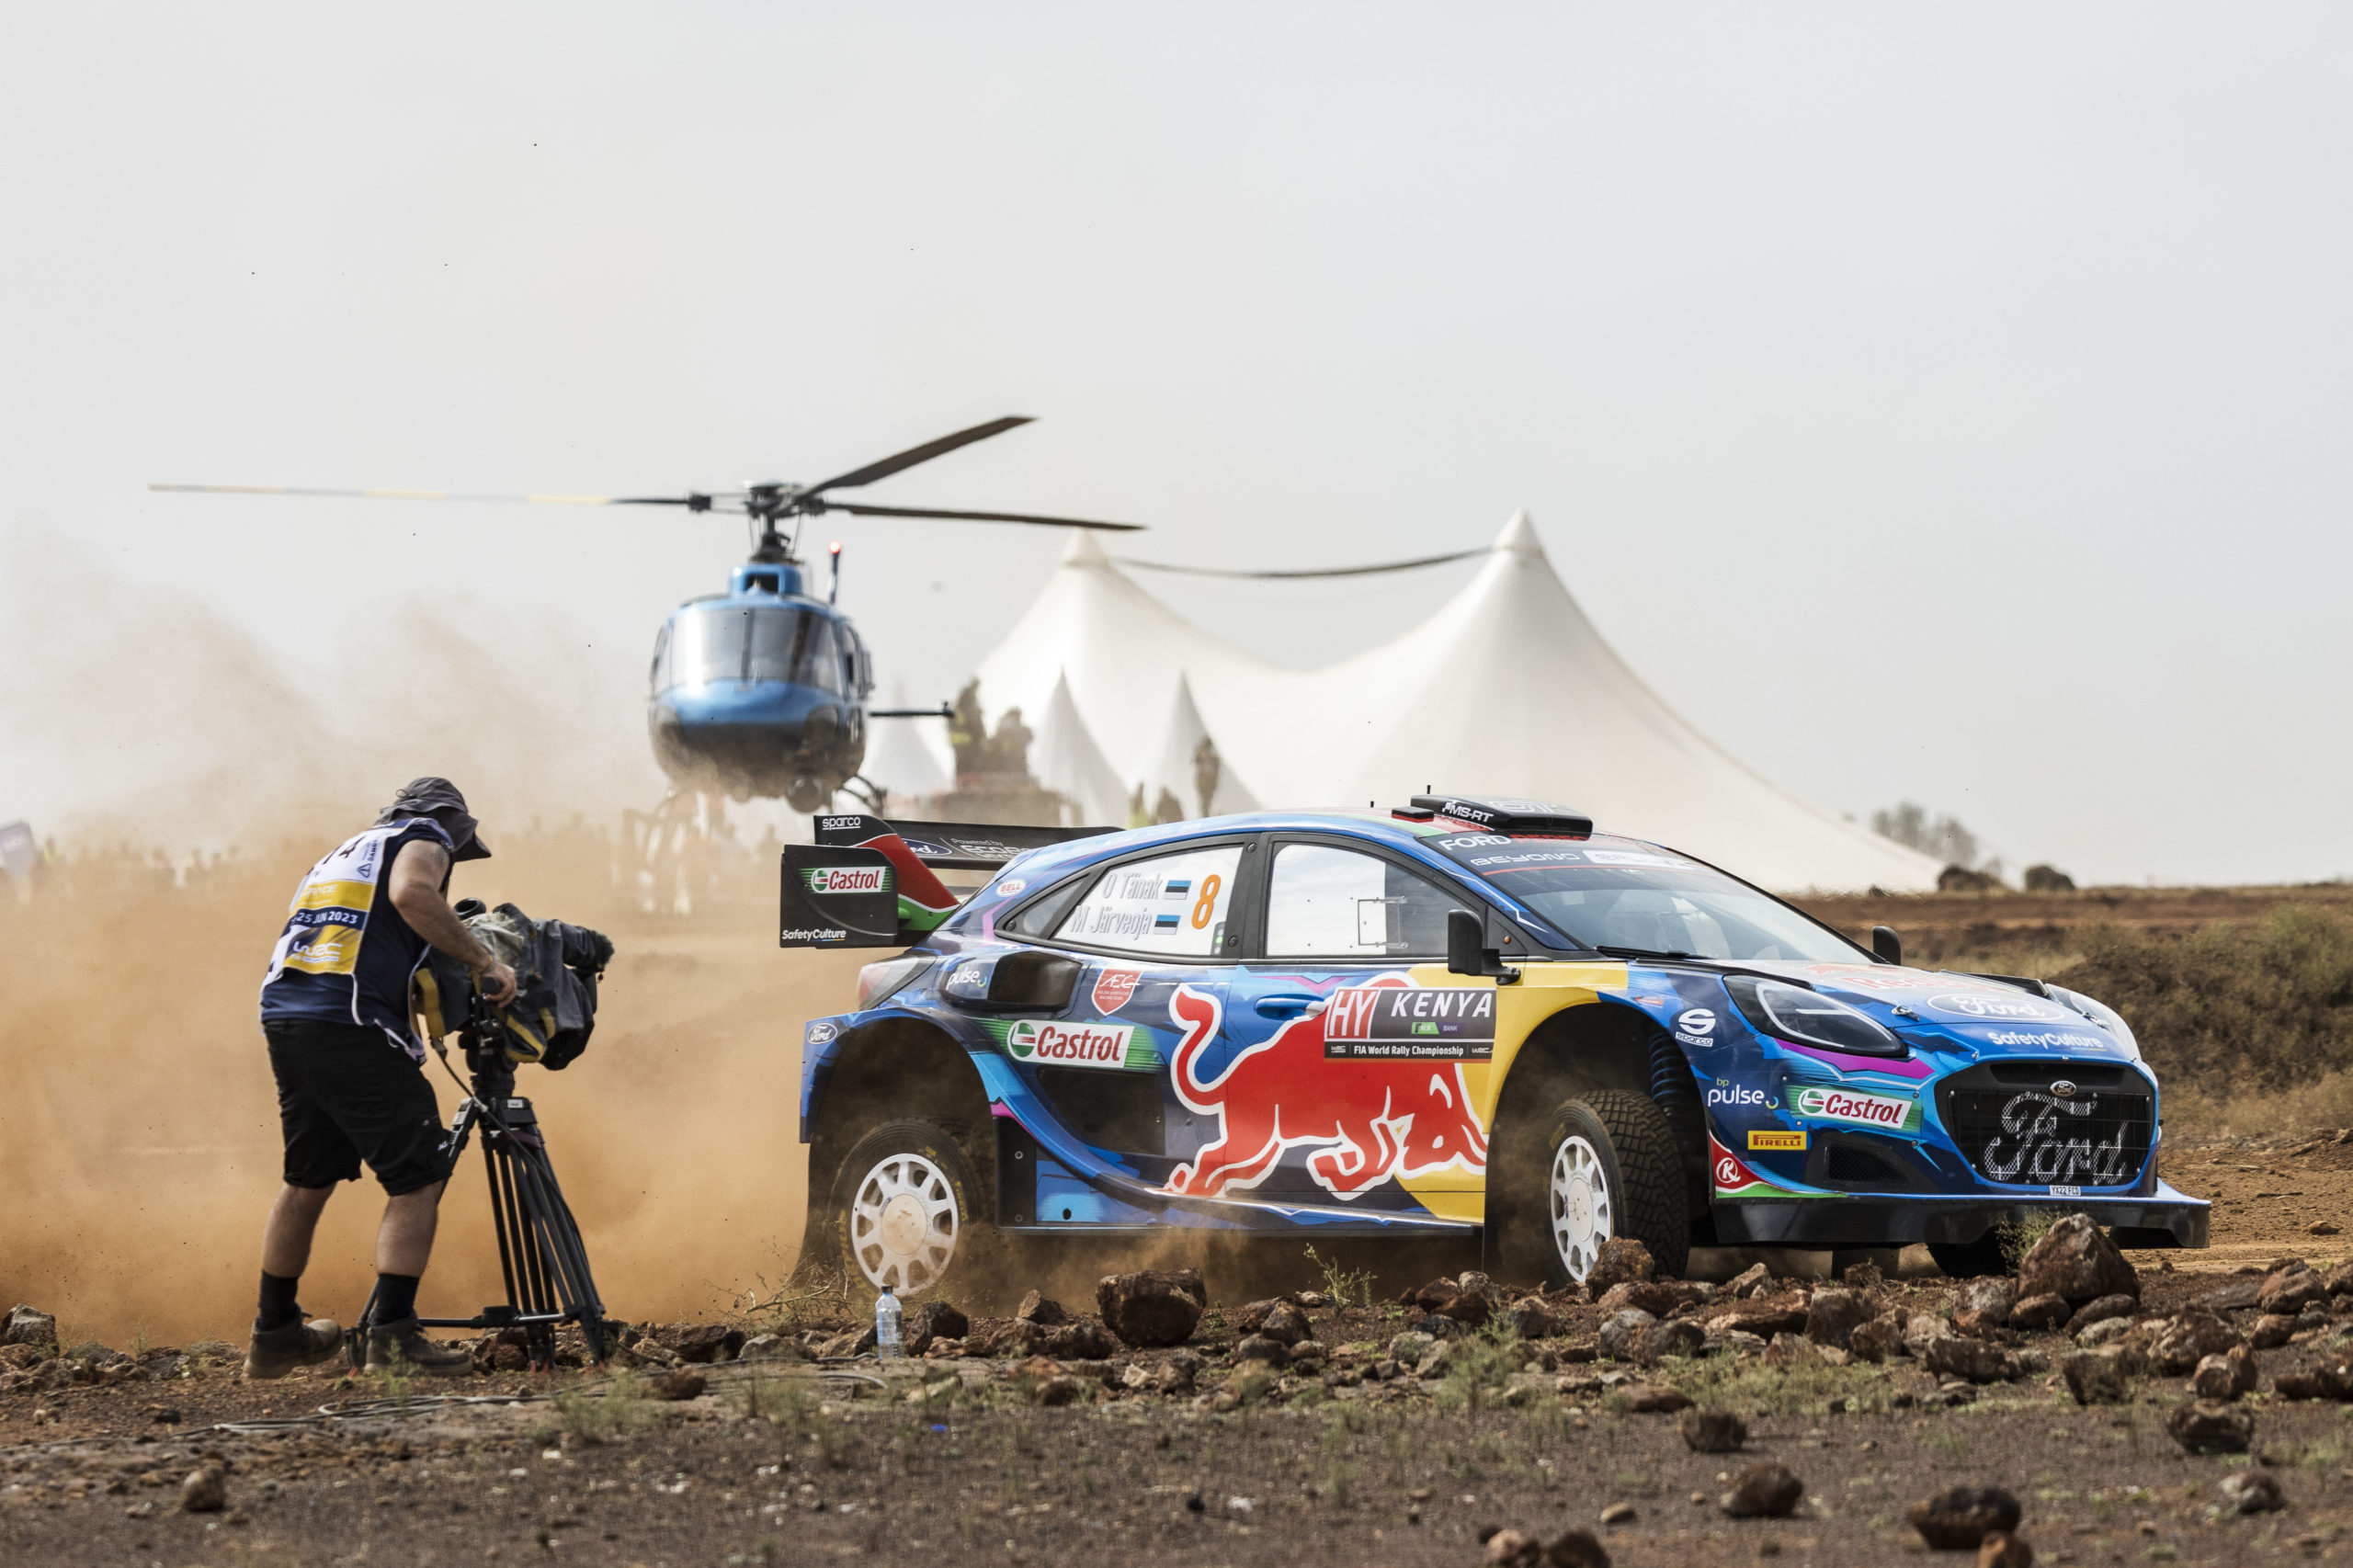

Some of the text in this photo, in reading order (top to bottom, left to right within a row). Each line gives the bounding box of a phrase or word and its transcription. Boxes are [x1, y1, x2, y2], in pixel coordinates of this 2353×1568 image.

[822, 816, 861, 830] sparco
[950, 837, 989, 846] Powered
[1438, 835, 1512, 851] FORD
[1471, 853, 1582, 866] BEYOND
[829, 869, 881, 891] Castrol
[999, 882, 1021, 892] BELL
[1103, 872, 1164, 900] O Tänak
[1190, 873, 1222, 930] 8
[312, 911, 328, 925] JUN
[328, 911, 358, 924] 2023
[1070, 904, 1154, 941] M Järveoja
[781, 928, 847, 942] SafetyCulture
[946, 968, 981, 991] pulse
[1328, 990, 1379, 1037] HY
[1391, 992, 1494, 1017] KENYA
[1950, 994, 2047, 1017] Ford
[1037, 1024, 1123, 1062] Castrol
[1677, 1032, 1712, 1045] sparco
[1986, 1032, 2104, 1049] SafetyCulture
[1354, 1045, 1367, 1054] FIA
[1368, 1045, 1390, 1054] World
[1391, 1045, 1411, 1056] Rally
[1412, 1045, 1464, 1057] Championship
[1716, 1077, 1730, 1088] bp
[1707, 1084, 1765, 1108] pulse
[1825, 1094, 1904, 1124] Castrol
[1752, 1134, 1802, 1147] PIRELLI
[1984, 1091, 2130, 1185] Ford
